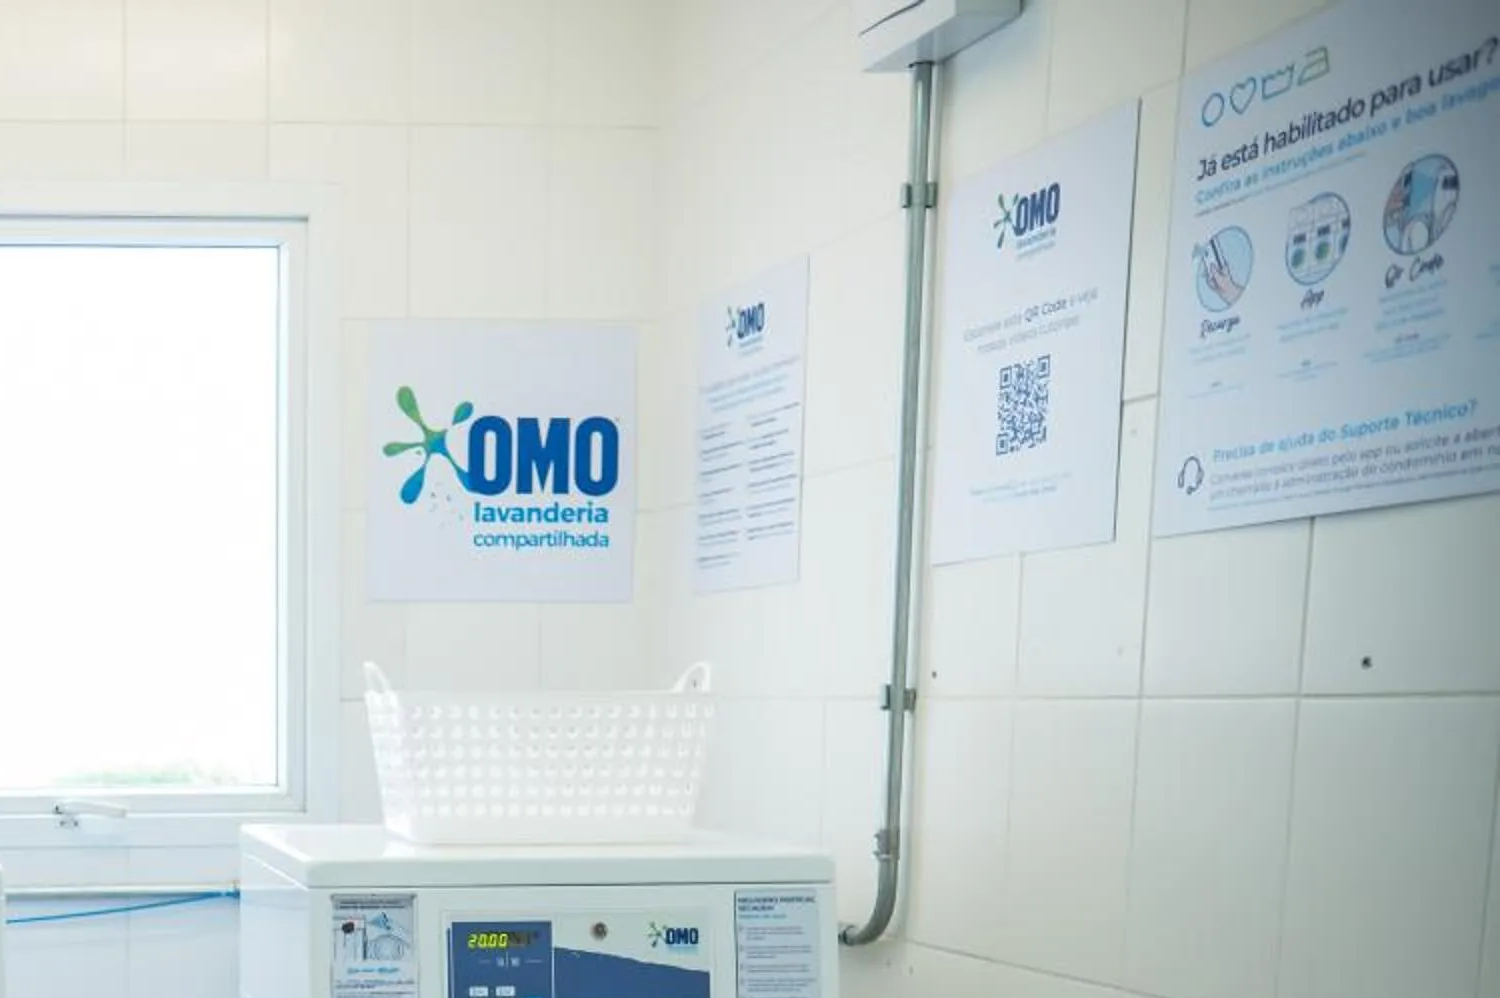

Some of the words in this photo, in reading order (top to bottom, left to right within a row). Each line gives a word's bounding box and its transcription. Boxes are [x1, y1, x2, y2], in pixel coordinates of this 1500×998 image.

[1197, 153, 1217, 181] Já
[1221, 135, 1259, 170] está
[1263, 97, 1366, 155] habilitado
[1370, 73, 1422, 119] para
[1428, 36, 1498, 88] usar?
[1013, 181, 1060, 236] OMO
[737, 302, 766, 340] OMO
[1340, 416, 1400, 439] Suporte
[468, 415, 619, 496] OMO
[474, 501, 609, 523] lavanderia
[473, 530, 609, 550] compartilhada
[665, 927, 699, 945] OMO
